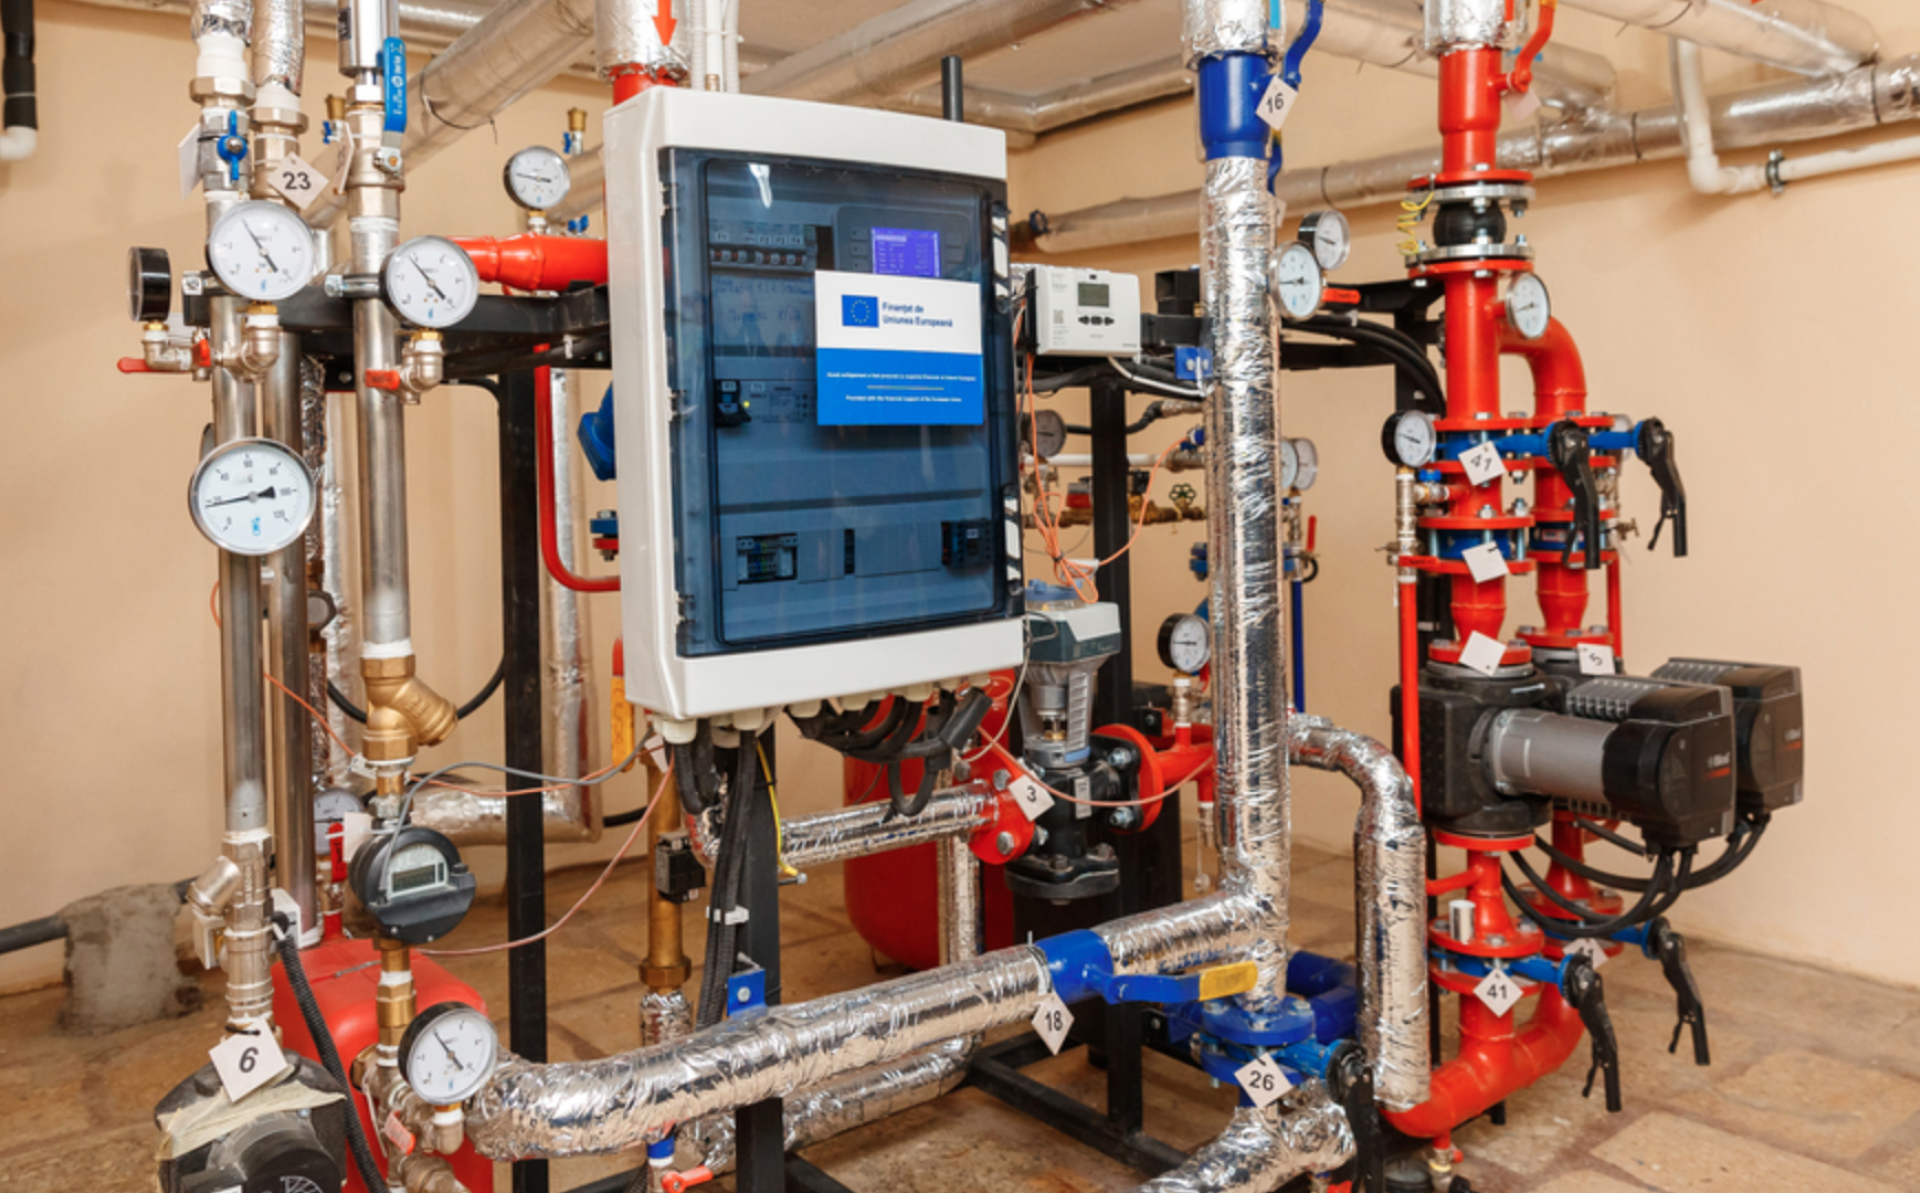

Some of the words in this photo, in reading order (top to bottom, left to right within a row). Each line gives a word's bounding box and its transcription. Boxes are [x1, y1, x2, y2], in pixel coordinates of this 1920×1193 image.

[1266, 92, 1284, 114] 16
[282, 171, 312, 191] 23
[914, 305, 924, 313] de
[882, 315, 913, 326] Uniunea
[1589, 652, 1603, 667] 5
[1027, 785, 1037, 803] 3
[1487, 984, 1508, 999] 41
[1045, 1010, 1063, 1032] 18
[238, 1046, 259, 1073] 6
[1249, 1070, 1275, 1091] 26
